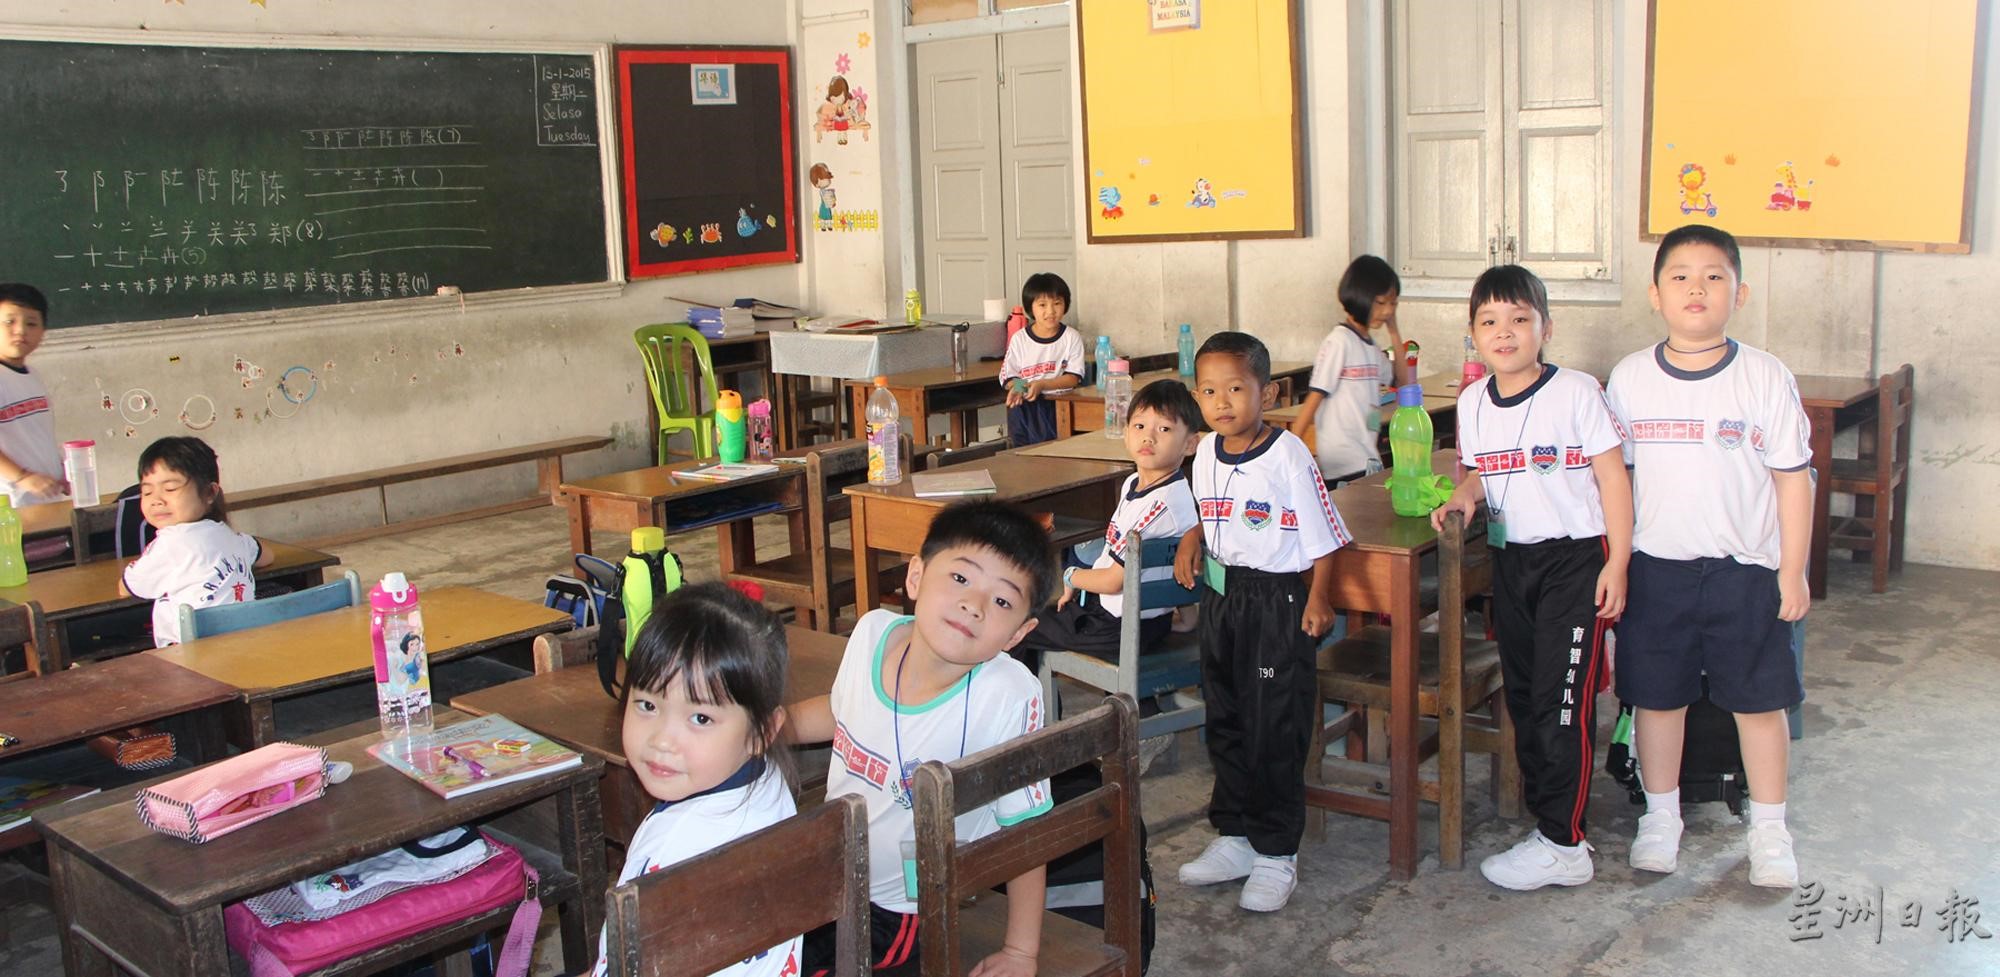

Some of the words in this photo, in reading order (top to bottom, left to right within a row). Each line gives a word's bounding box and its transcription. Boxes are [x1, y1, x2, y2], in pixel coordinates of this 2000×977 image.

[551, 82, 588, 101] 星期二
[543, 125, 590, 143] Tuesday
[1258, 667, 1274, 679] T90
